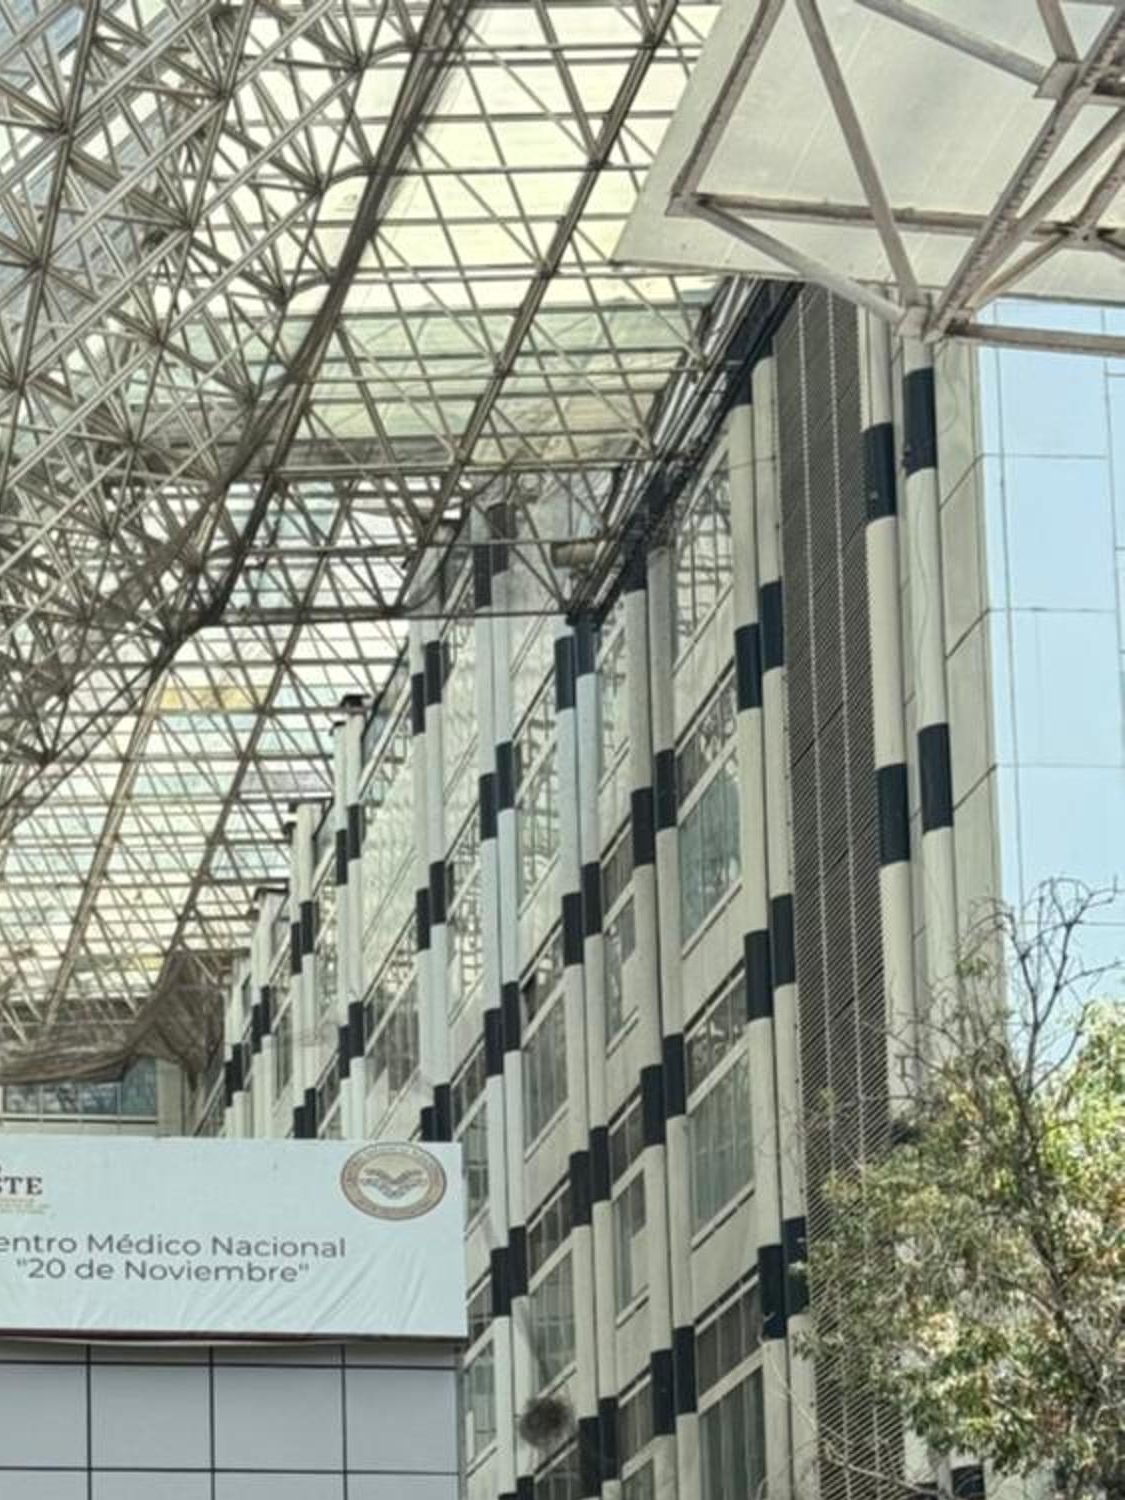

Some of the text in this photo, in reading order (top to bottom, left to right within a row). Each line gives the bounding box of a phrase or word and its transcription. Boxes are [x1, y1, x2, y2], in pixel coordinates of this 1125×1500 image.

[87, 1232, 202, 1257] Médico
[211, 1235, 347, 1259] Nacional
[16, 1256, 310, 1284] "20 de Noviembre"
